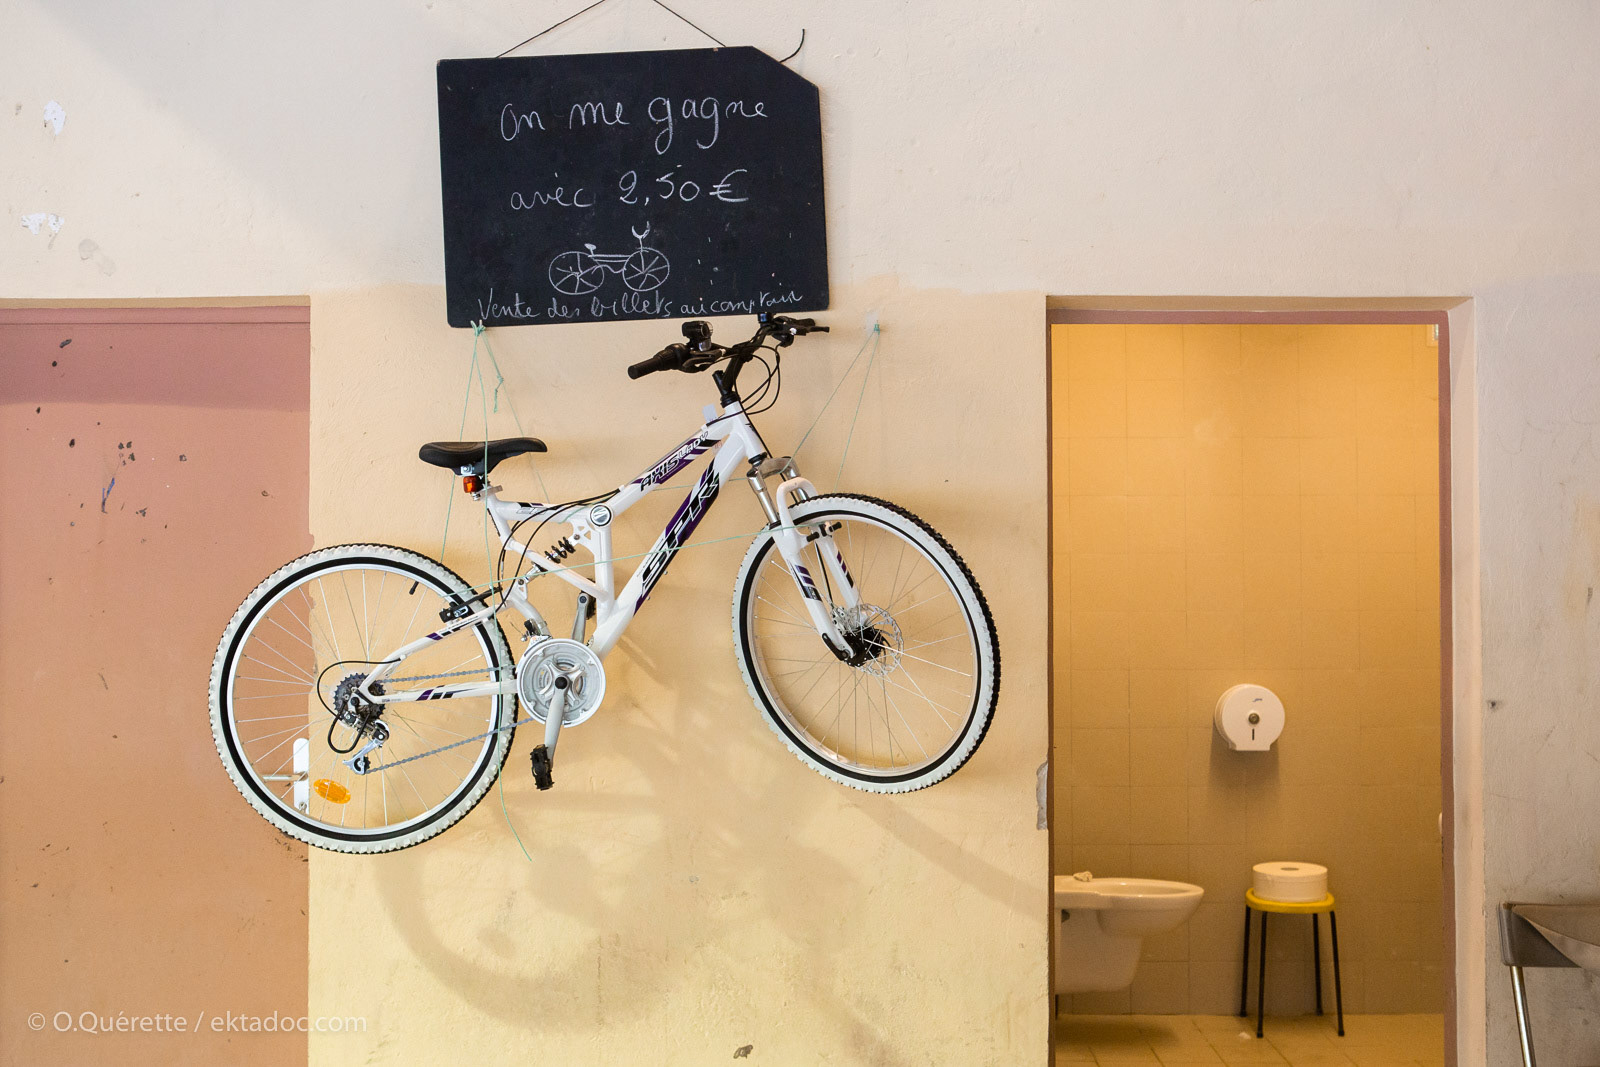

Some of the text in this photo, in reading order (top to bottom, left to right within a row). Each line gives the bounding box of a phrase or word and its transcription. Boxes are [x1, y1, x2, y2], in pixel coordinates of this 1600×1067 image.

[500, 96, 768, 155] On me gagne
[478, 287, 541, 320] Vente
[547, 297, 580, 319] des
[590, 289, 673, 318] billets
[640, 453, 680, 491] AXIS
[678, 430, 709, 459] LADY
